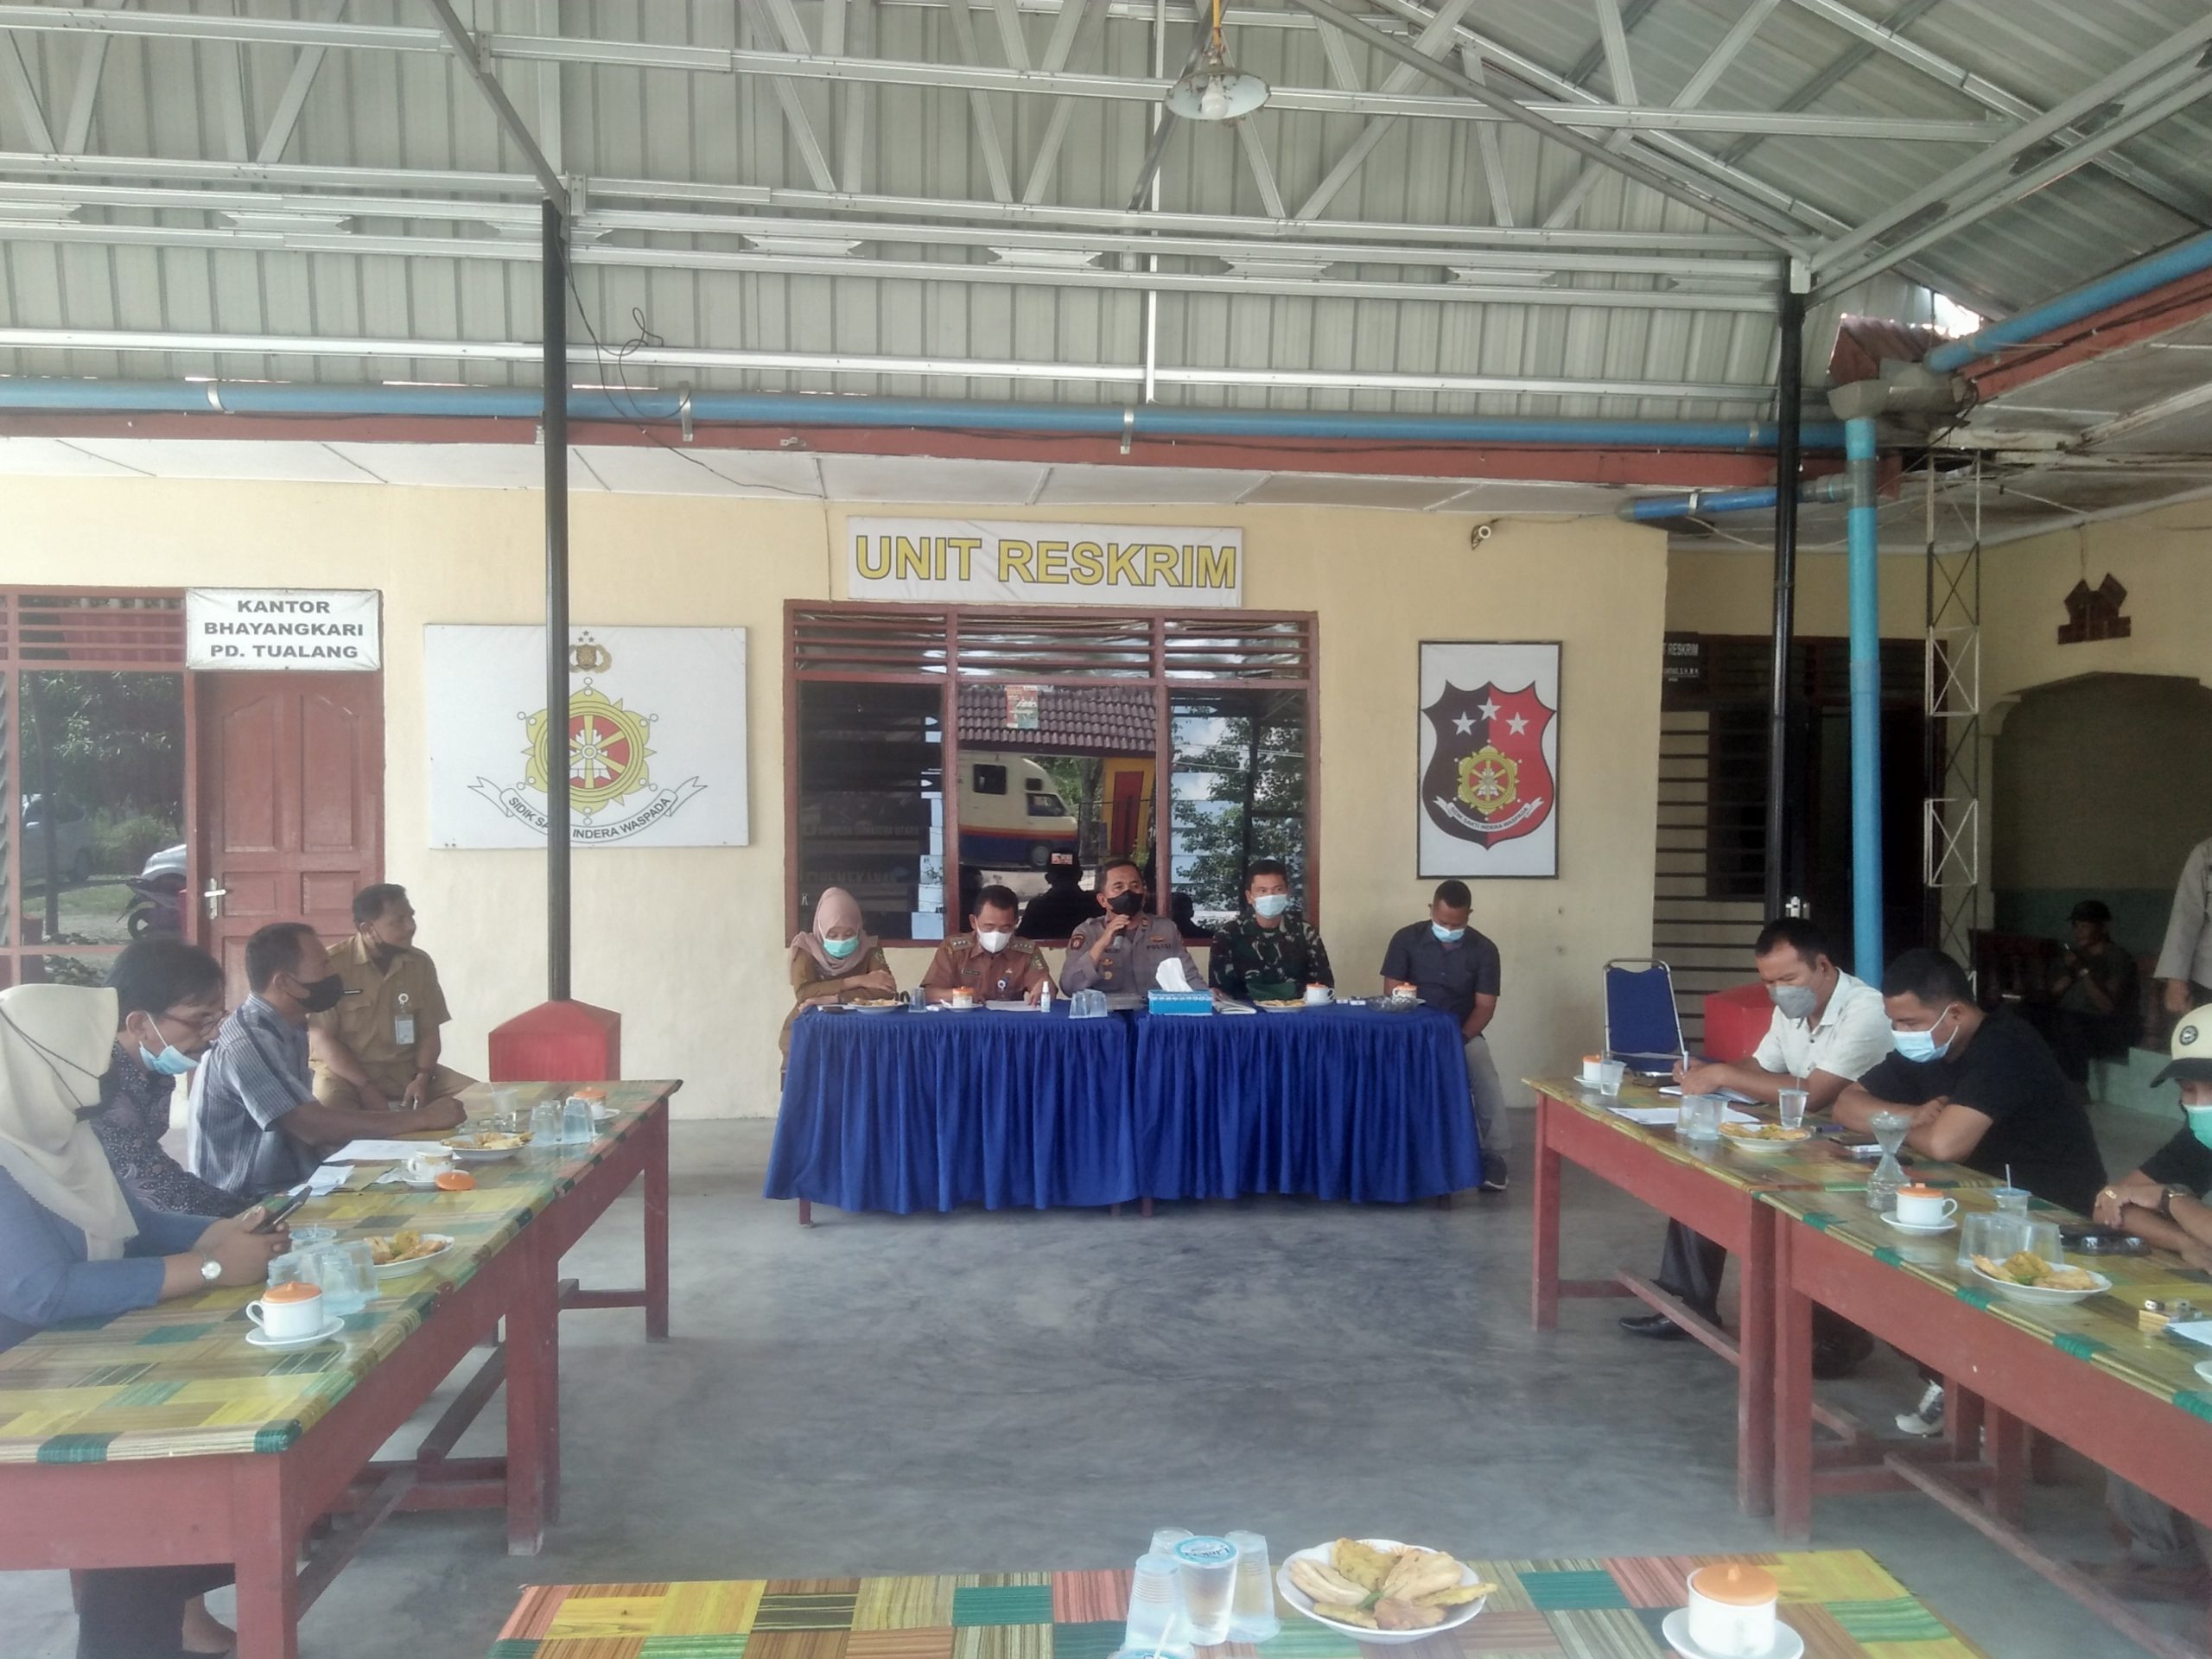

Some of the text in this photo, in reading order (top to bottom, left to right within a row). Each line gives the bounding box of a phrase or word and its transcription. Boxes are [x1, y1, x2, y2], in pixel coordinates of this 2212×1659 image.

[855, 535, 1236, 589] UNIT RESKRIM
[238, 600, 331, 613] KANTOR
[204, 622, 364, 637] BHAYANGKARI
[211, 645, 359, 658] PD. TUALANG
[509, 798, 671, 839] SIDIK INDERA WASPADA
